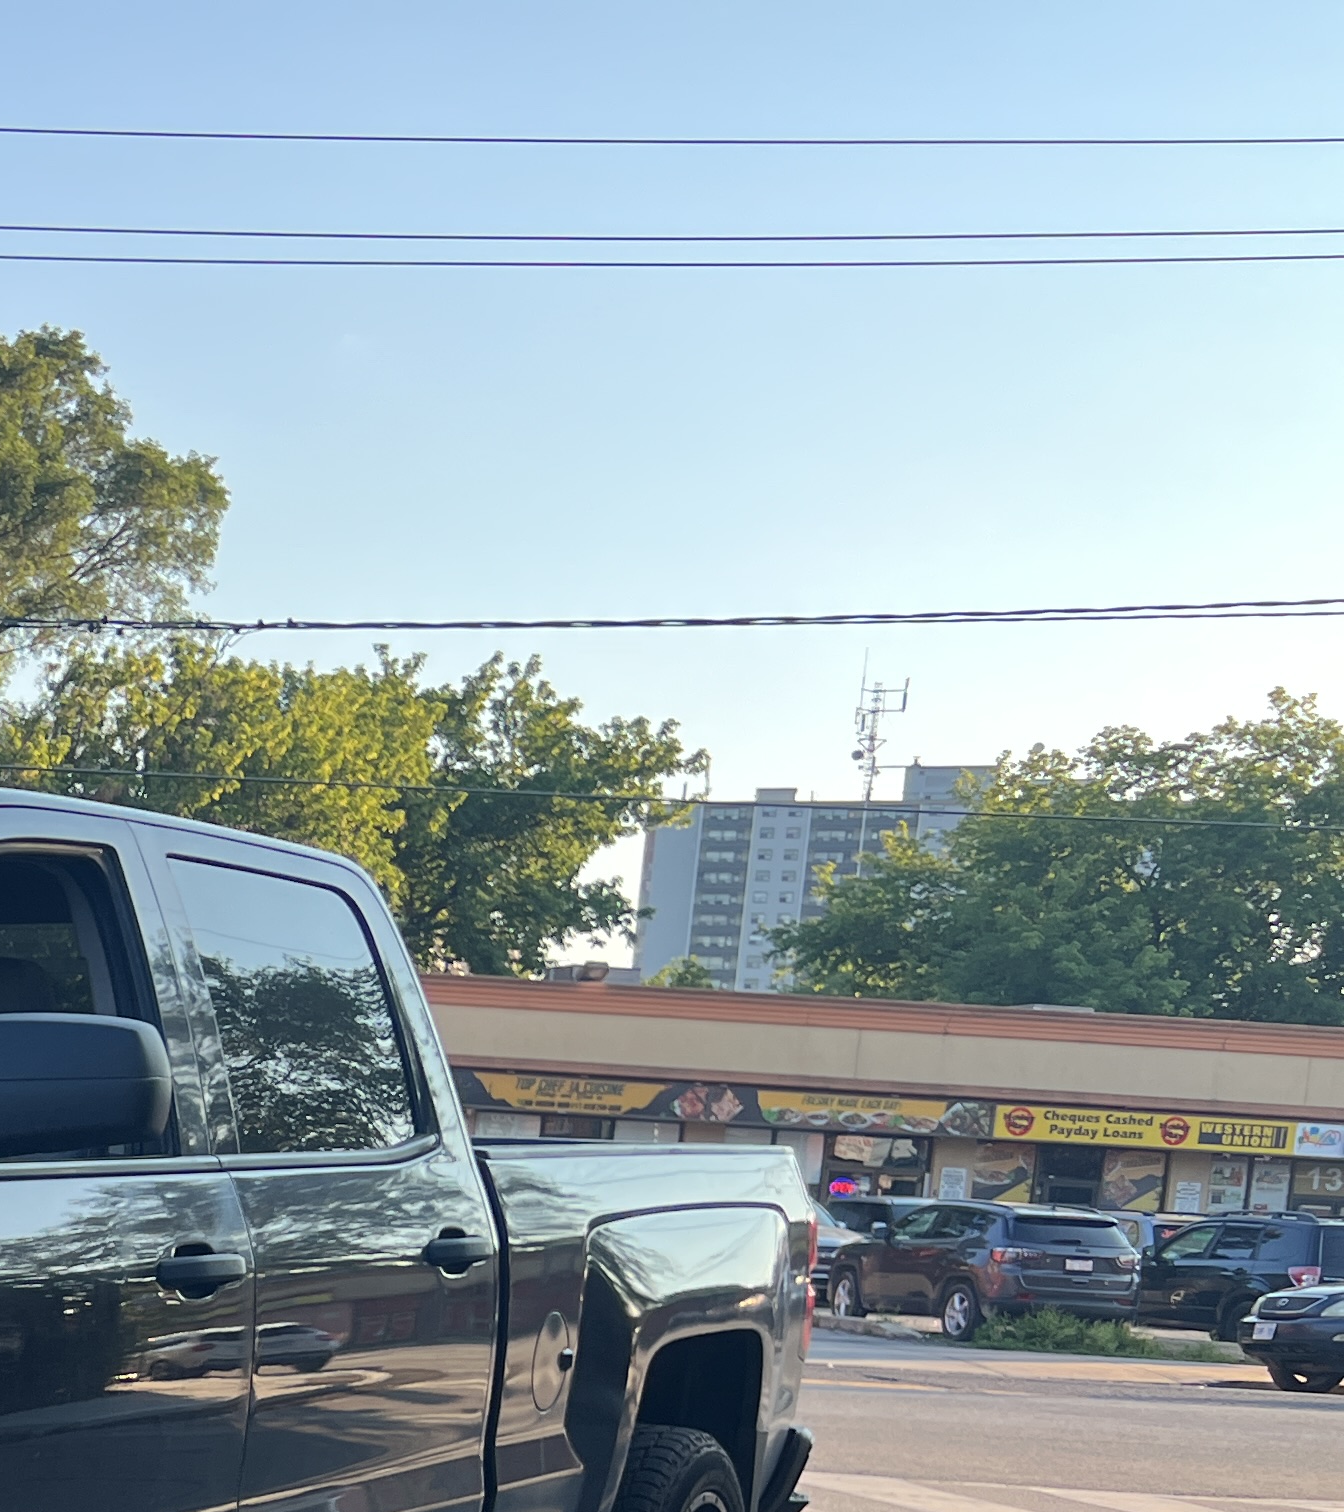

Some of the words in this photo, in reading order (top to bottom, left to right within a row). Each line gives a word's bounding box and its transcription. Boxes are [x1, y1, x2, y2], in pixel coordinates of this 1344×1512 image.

[1044, 1110, 1100, 1124] Cheques
[1105, 1114, 1154, 1126] Cashed
[1049, 1124, 1097, 1139] Payday
[1103, 1128, 1143, 1139] Loans
[1201, 1122, 1273, 1136] WESTERN
[1222, 1135, 1273, 1147] UNION
